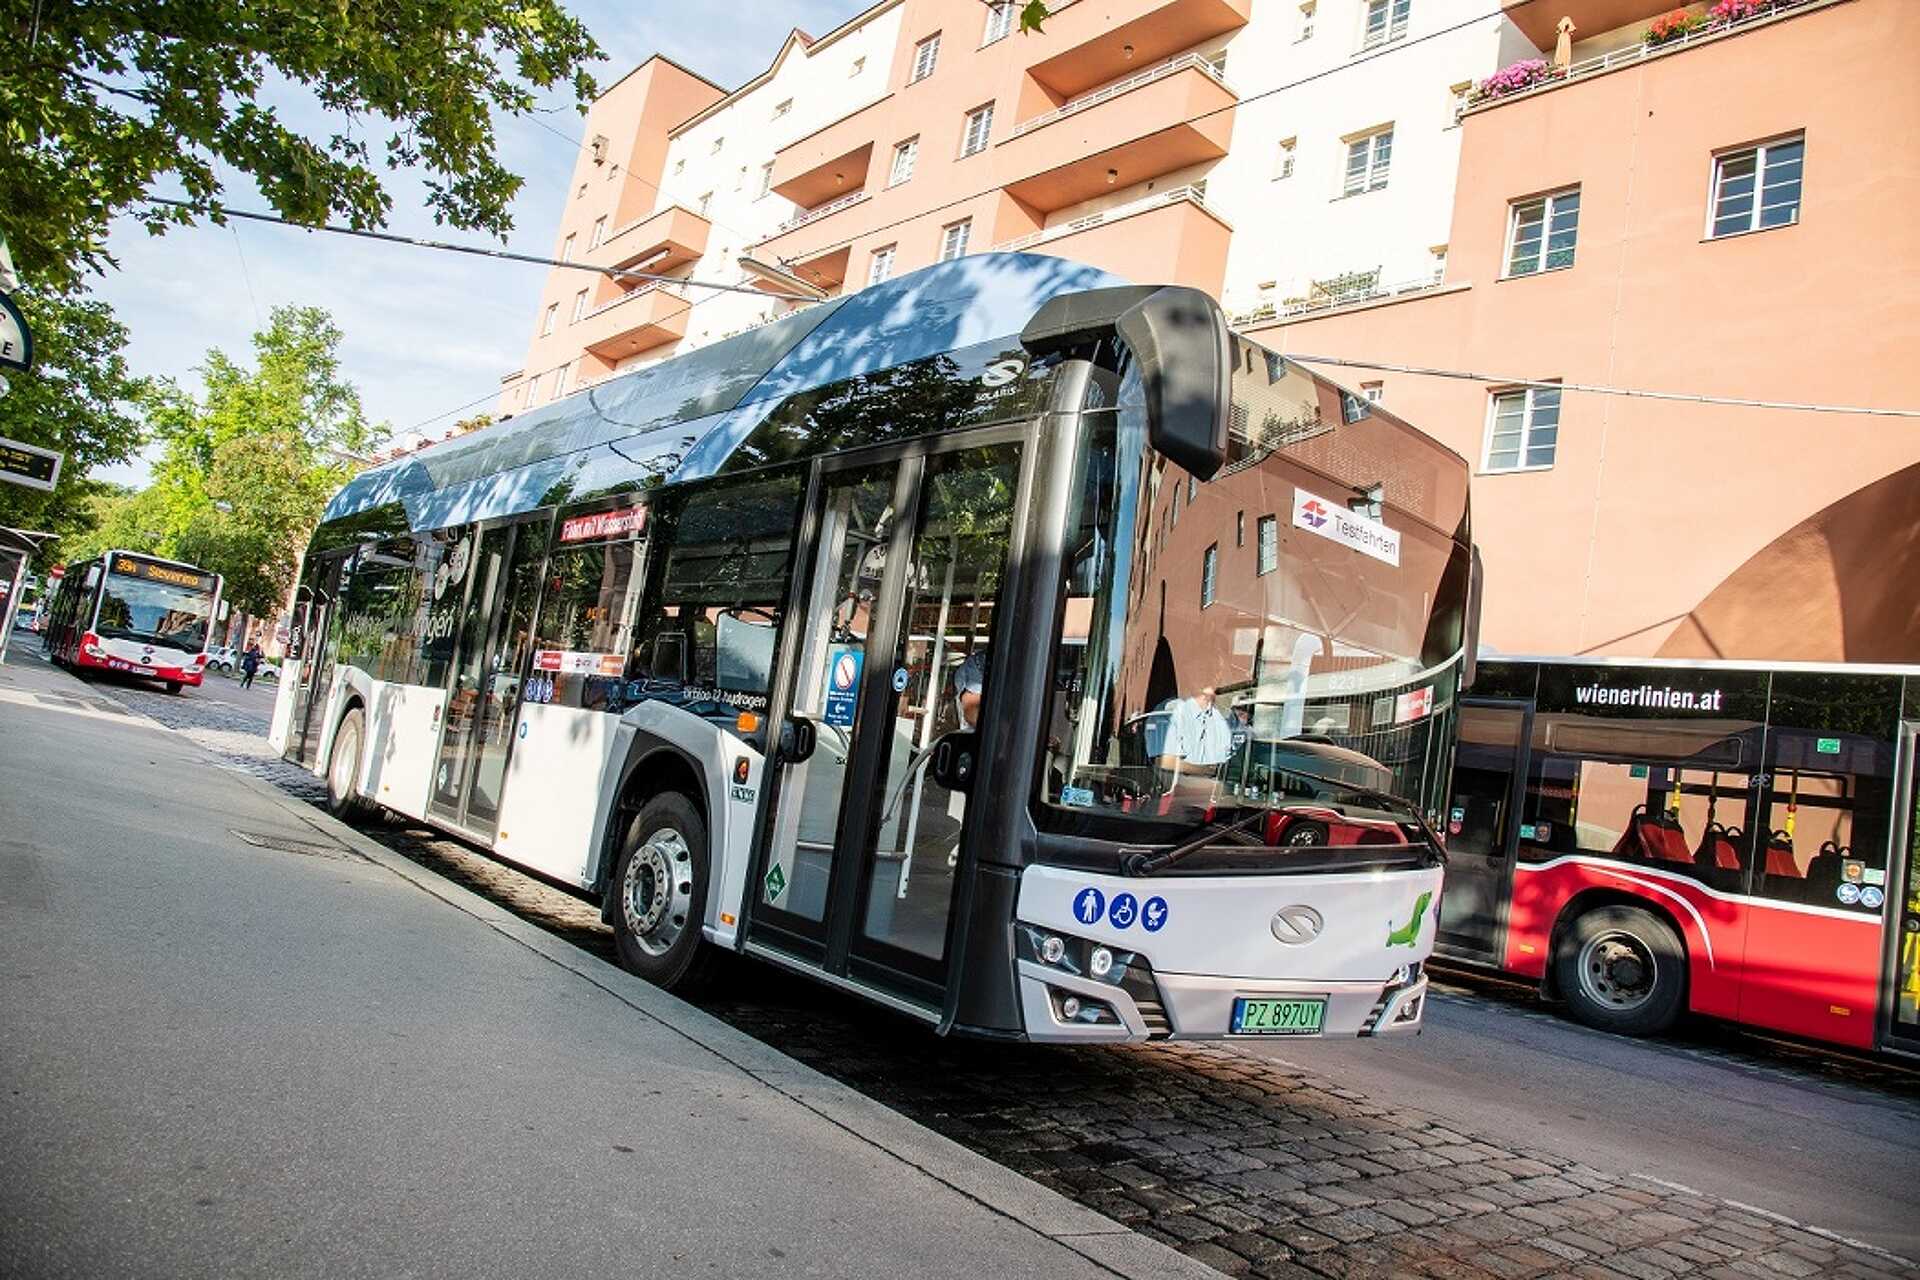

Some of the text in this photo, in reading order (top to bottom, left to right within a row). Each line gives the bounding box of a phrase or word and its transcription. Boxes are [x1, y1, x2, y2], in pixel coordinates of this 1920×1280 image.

[1334, 513, 1396, 554] Testfahrten
[723, 690, 767, 709] hydrogen
[1576, 683, 1721, 710] wienerlinien.at
[1245, 1003, 1319, 1026] PZ 897UY
